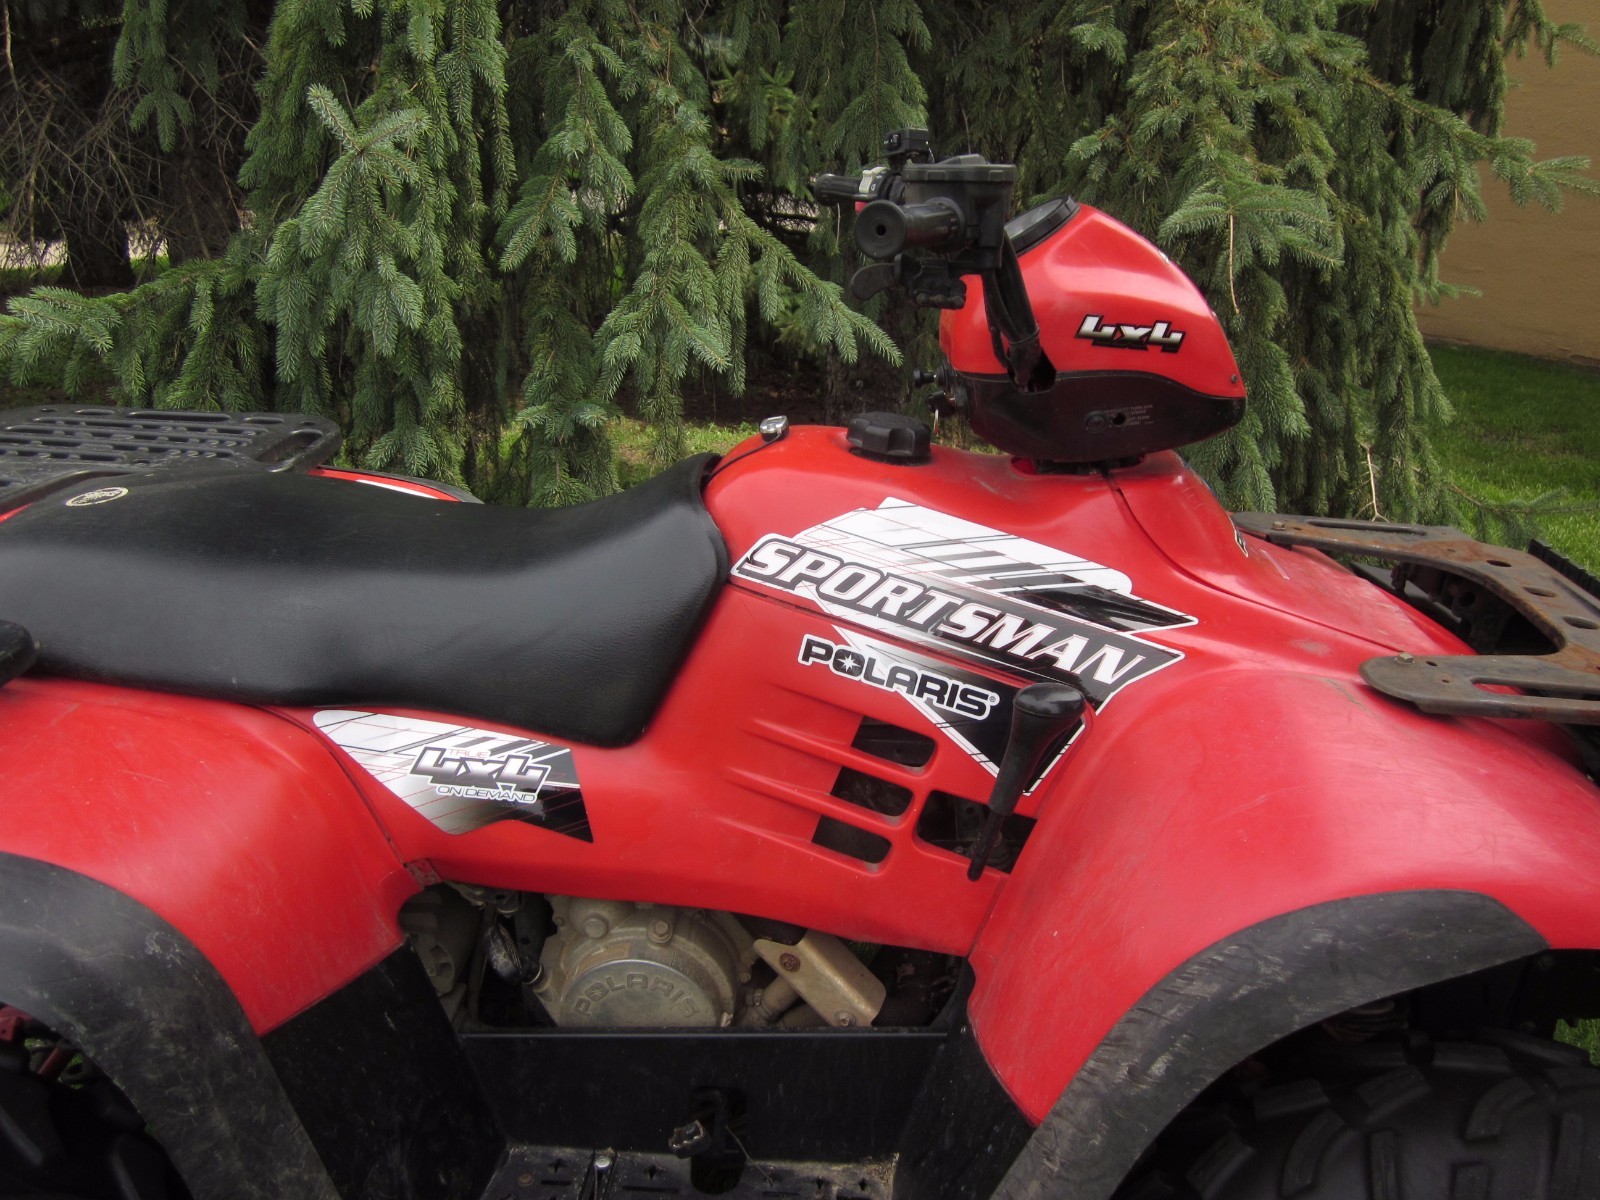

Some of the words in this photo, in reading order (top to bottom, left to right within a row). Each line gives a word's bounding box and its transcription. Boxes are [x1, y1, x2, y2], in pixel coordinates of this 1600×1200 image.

[1075, 314, 1186, 353] 4x4
[739, 539, 1146, 686] SPORTSMAN
[410, 746, 549, 793] 4x4
[449, 748, 489, 759] TRUE
[437, 785, 462, 796] ON
[465, 787, 536, 802] DEMAND
[574, 971, 702, 1018] POLARIS
